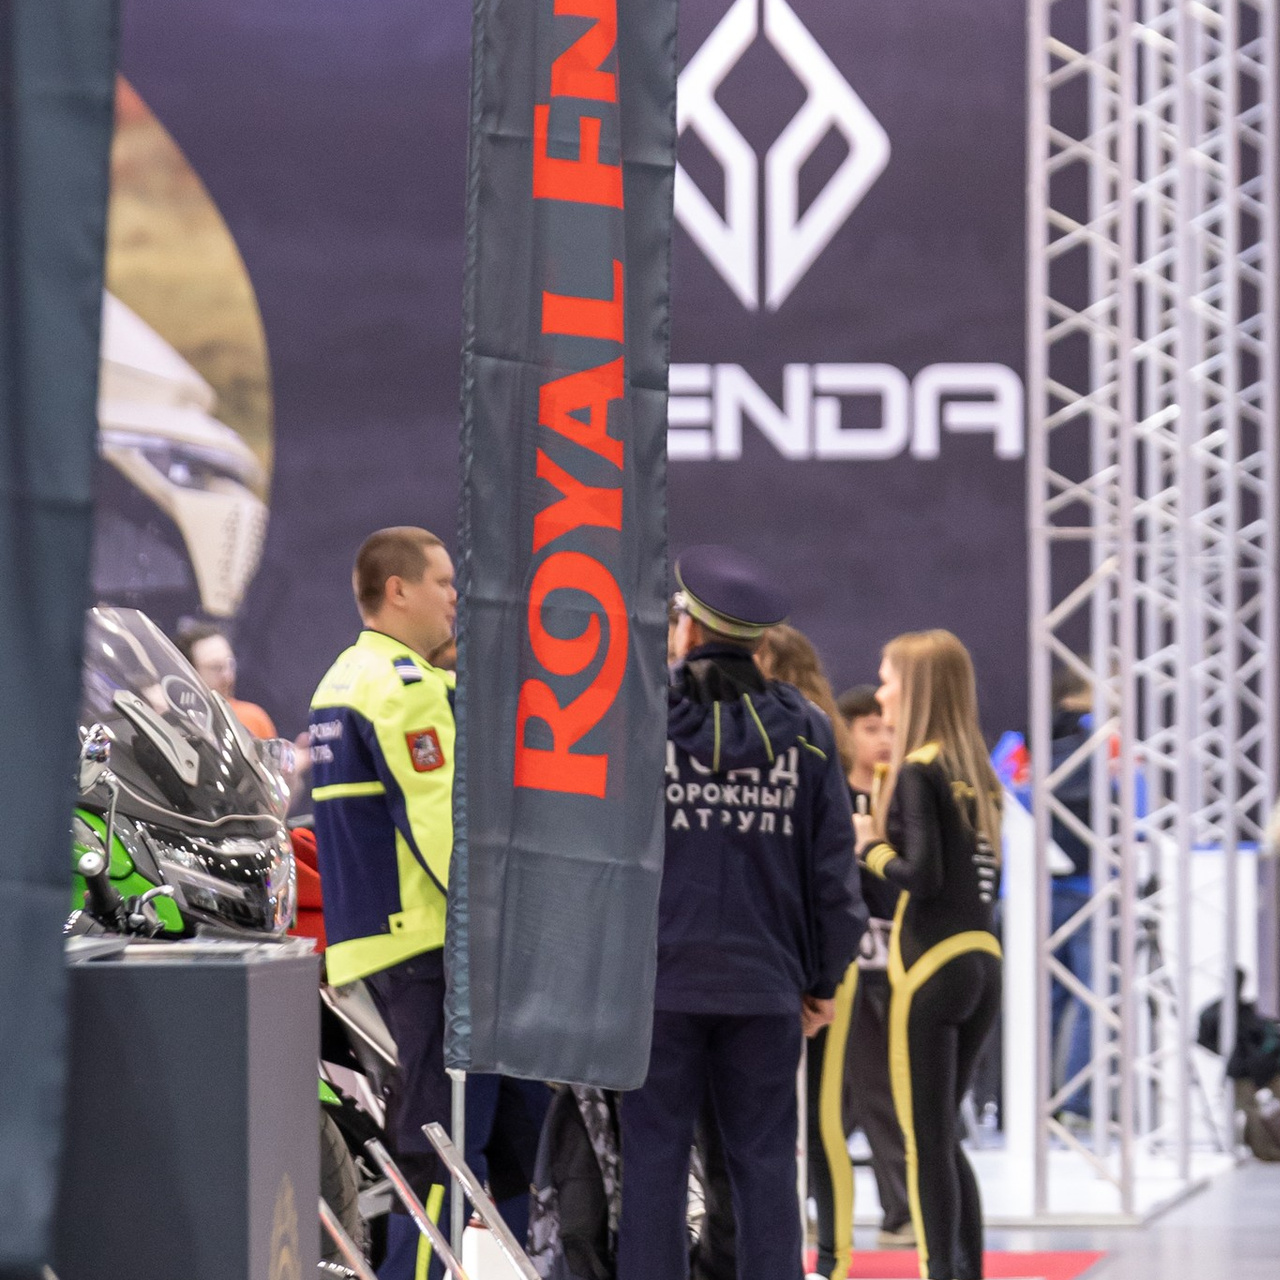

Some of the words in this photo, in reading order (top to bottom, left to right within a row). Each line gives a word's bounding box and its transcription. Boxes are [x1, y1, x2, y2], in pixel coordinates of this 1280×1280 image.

[667, 362, 1025, 461] ENDA
[514, 258, 630, 800] ROYAL
[666, 783, 796, 808] ОРОЖНЫЙ
